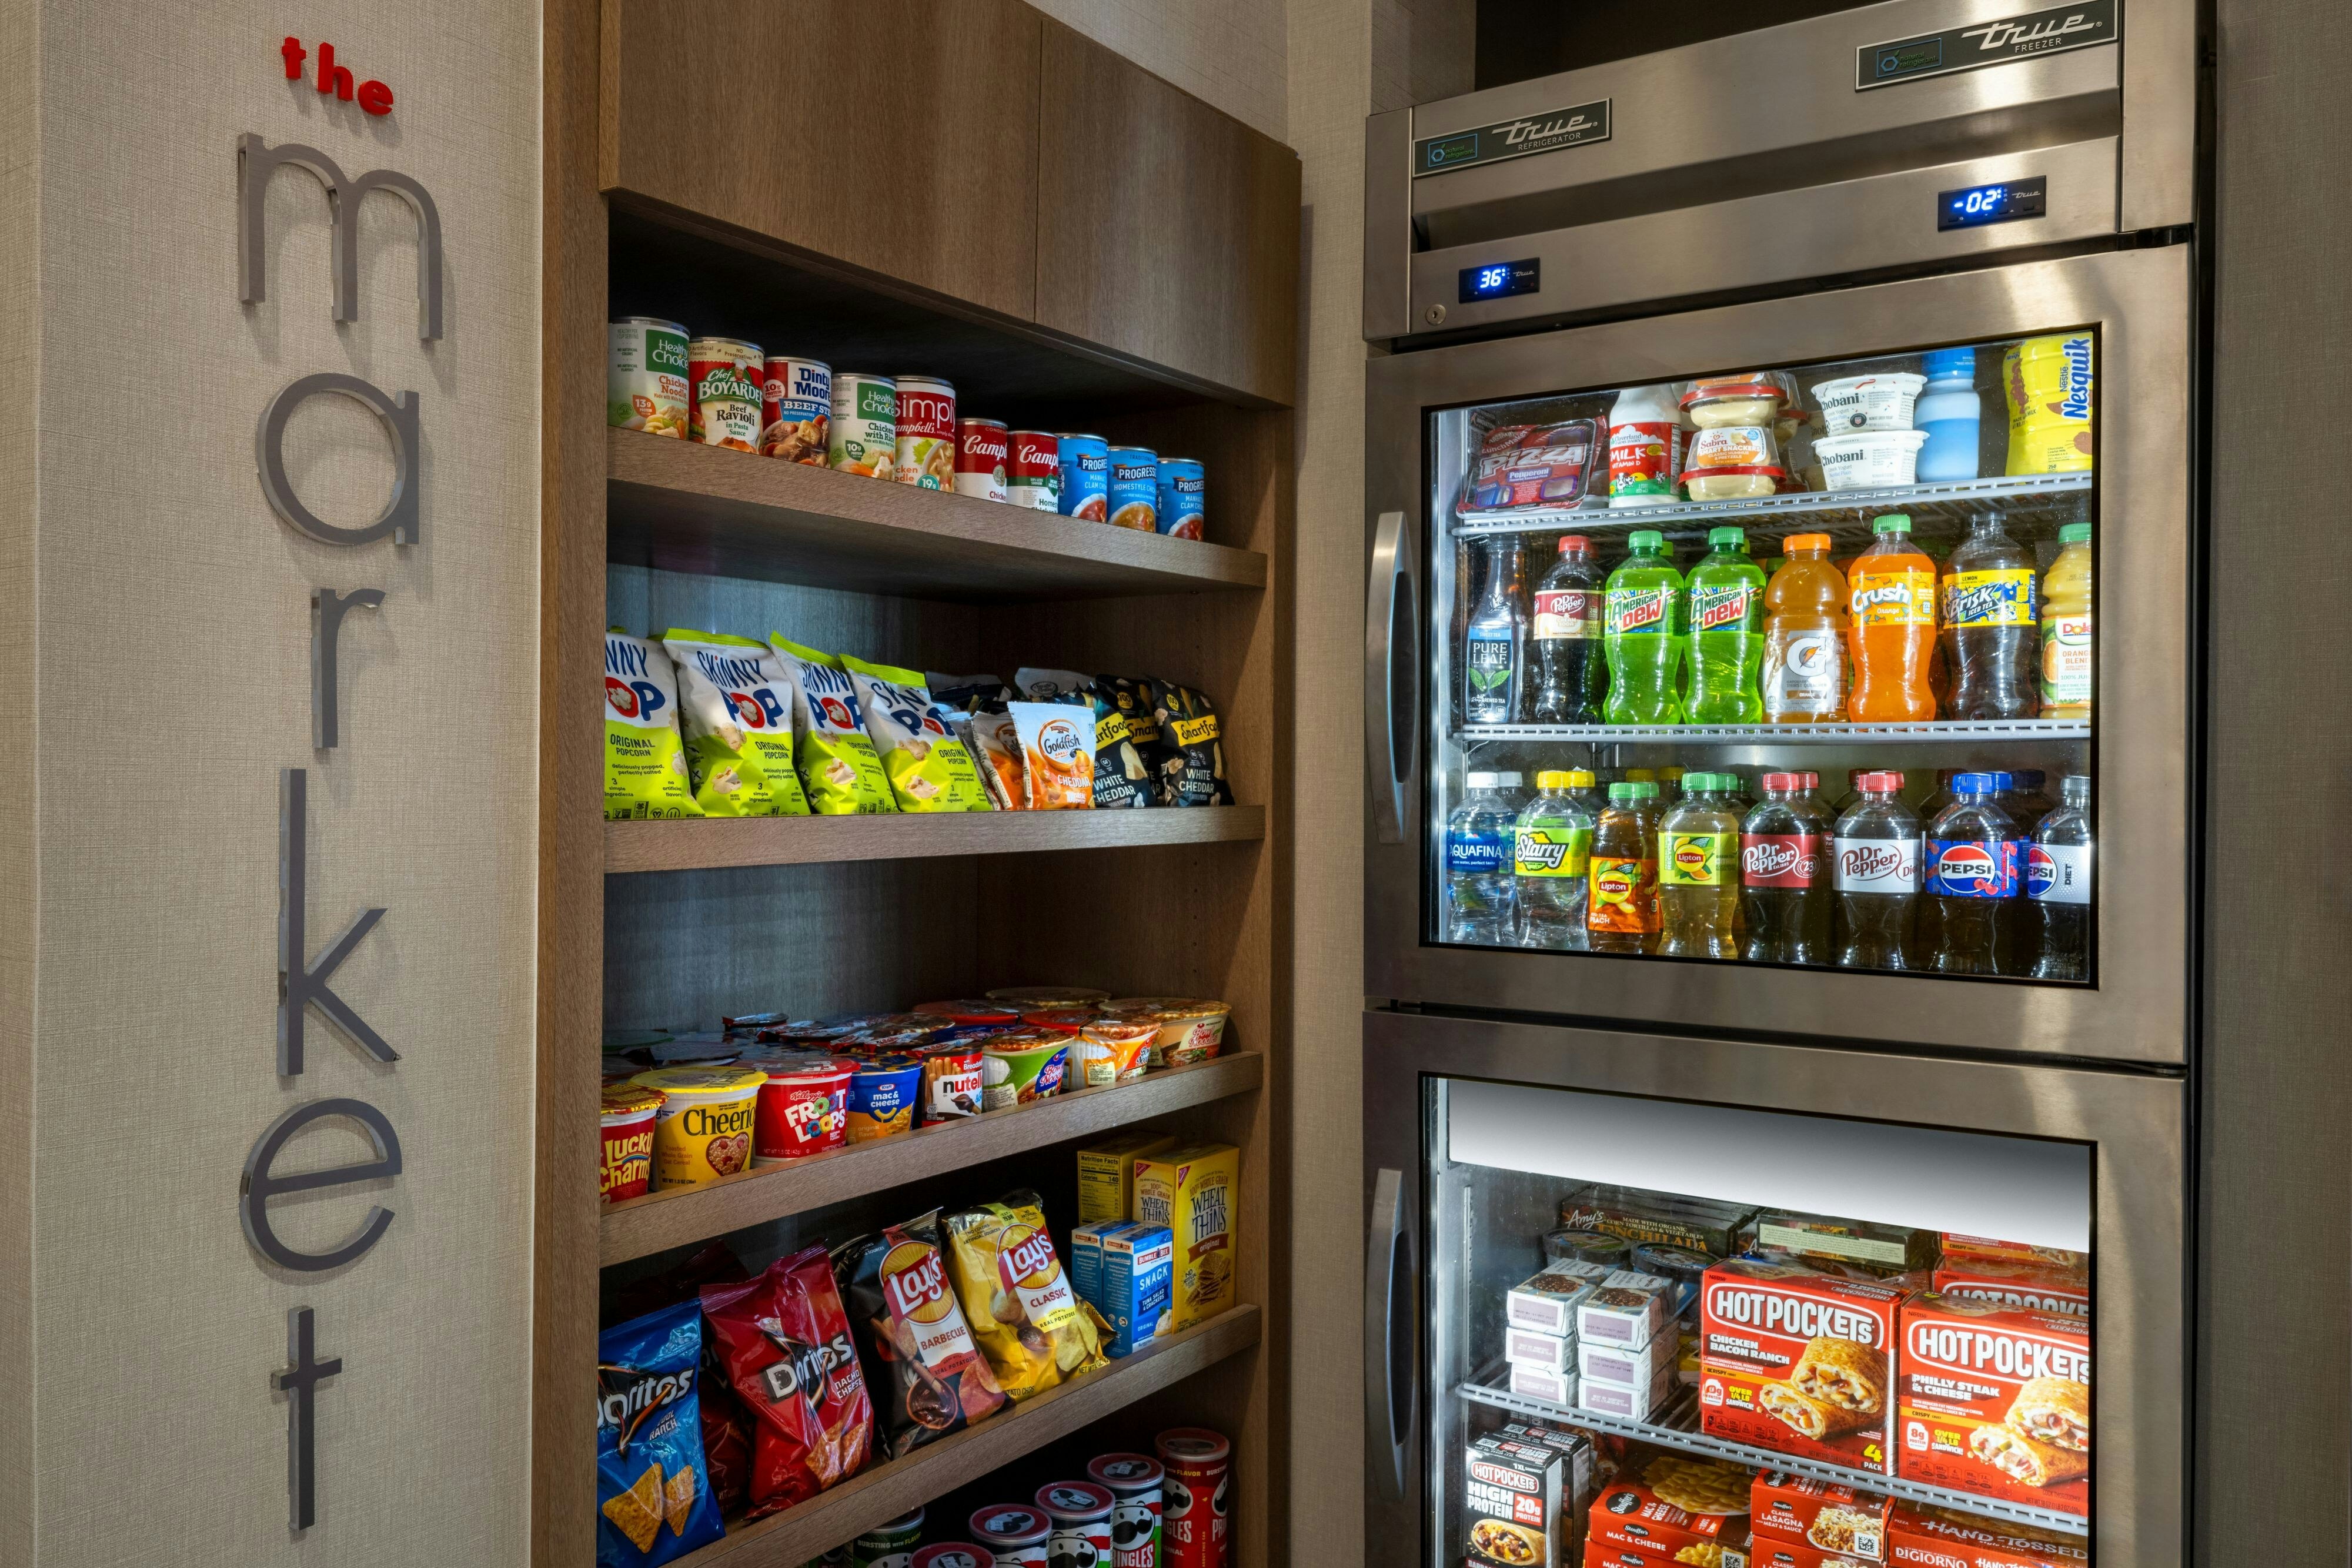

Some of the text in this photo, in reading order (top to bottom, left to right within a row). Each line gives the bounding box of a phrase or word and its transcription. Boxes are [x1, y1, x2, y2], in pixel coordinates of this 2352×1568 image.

[2015, 38, 2062, 54] FREEZER
[1899, 55, 1937, 68] refrigerant
[1900, 52, 1925, 61] natural
[281, 36, 394, 116] the
[1445, 145, 1465, 153] natural
[1518, 132, 1581, 151] REFRIGERATOR
[1445, 149, 1475, 159] refrigerant
[1479, 270, 1502, 288] 36
[659, 339, 687, 359] Healthy
[652, 350, 688, 370] Choice
[659, 376, 687, 390] Chicken
[707, 369, 732, 382] Chef
[799, 367, 829, 389] Dinty
[2063, 339, 2093, 419] Nesquik
[662, 385, 687, 399] Noodle
[868, 391, 894, 404] Healthy
[730, 404, 747, 413] Beef
[783, 401, 818, 411] BEEF
[863, 401, 896, 416] Choice
[717, 410, 754, 426] Ravioli
[734, 423, 749, 431] Pasta
[868, 422, 894, 434] Chicken
[1701, 438, 1728, 450] Sabra
[1723, 445, 1760, 453] SNACKERS
[1481, 443, 1588, 479] PIZZA
[1610, 447, 1646, 462] MILK
[1822, 449, 1863, 466] Chobani
[1509, 468, 1549, 479] Pepperoni
[1562, 595, 1575, 604] Dr
[1852, 582, 1912, 614] Crush
[1950, 587, 1993, 618] BRISK
[1552, 597, 1583, 615] Pepper
[1968, 606, 1982, 616] ICED
[1473, 643, 1507, 653] PURE
[1473, 654, 1506, 664] LEAF
[697, 651, 769, 689] SKINNY
[719, 688, 784, 728] POP
[610, 734, 655, 748] ORIGINAL
[1044, 733, 1081, 754] Goldfish
[616, 748, 651, 756] POPCORN
[1058, 775, 1091, 788] CHEDDAR
[1187, 769, 1210, 781] WHITE
[1179, 781, 1214, 794] CHEDDAR
[1449, 844, 1503, 858] AQUAFINA
[1516, 835, 1568, 868] Starry
[1758, 843, 1779, 857] Dr
[1859, 846, 1882, 859] Dr
[1746, 847, 1795, 873] Pepper
[1803, 860, 1814, 872] 23
[1846, 850, 1897, 876] Pepper
[1941, 862, 1992, 875] PEPSI
[1601, 883, 1626, 891] Lipton
[790, 1091, 823, 1101] Kellogg's
[784, 1089, 846, 1128] FROOT
[683, 1102, 755, 1136] Cheerio
[795, 1109, 846, 1143] LOOPS
[605, 1132, 653, 1168] Lucky
[1191, 1186, 1227, 1216] WHEAT
[1003, 1213, 1014, 1222] 1938
[1192, 1206, 1227, 1243] THINS
[1565, 1209, 1605, 1229] Amy's
[1625, 1222, 1658, 1232] TORTILLAS
[1665, 1229, 1704, 1239] VEGETABLES
[1658, 1223, 1688, 1232] ORGANIC
[1200, 1239, 1219, 1252] original
[1002, 1232, 1053, 1284] Lay's
[1139, 1253, 1157, 1263] BUMBLE
[888, 1250, 942, 1315] Lay's
[1140, 1265, 1168, 1290] SNACK
[1030, 1288, 1067, 1308] CLASSIC
[1040, 1311, 1075, 1328] REAL POTATOES
[1716, 1290, 1873, 1345] HOT POCKETS
[1138, 1322, 1153, 1331] ORIGINAL
[920, 1326, 965, 1350] BARBECUE
[1710, 1333, 1758, 1349] CHICKEN
[1710, 1342, 1790, 1365] BACON RANCH
[1919, 1328, 1973, 1368] HOT
[766, 1334, 852, 1399] Doritos
[949, 1356, 975, 1370] POTATOES
[835, 1369, 860, 1389] NACHO
[1912, 1373, 2000, 1397] PHILLY STEAK
[837, 1378, 863, 1399] CHEESE
[1729, 1386, 1752, 1395] OVER
[1925, 1386, 1972, 1400] CHEESE
[1726, 1398, 1754, 1410] SANDWICH!
[649, 1419, 677, 1441] RANCH
[1911, 1428, 1925, 1440] 8g
[1864, 1462, 1882, 1471] PACK
[1475, 1465, 1536, 1490] HOT POCKETS
[1468, 1481, 1514, 1505] HIGH
[1467, 1494, 1514, 1520] PROTEIN
[1516, 1496, 1541, 1515] 20g
[1516, 1512, 1541, 1523] PROTEIN
[1762, 1513, 1803, 1528] LASAGNA
[1771, 1510, 1794, 1518] CLASSIC
[1606, 1531, 1625, 1543] MAC
[1624, 1525, 1649, 1536] Stouffer's
